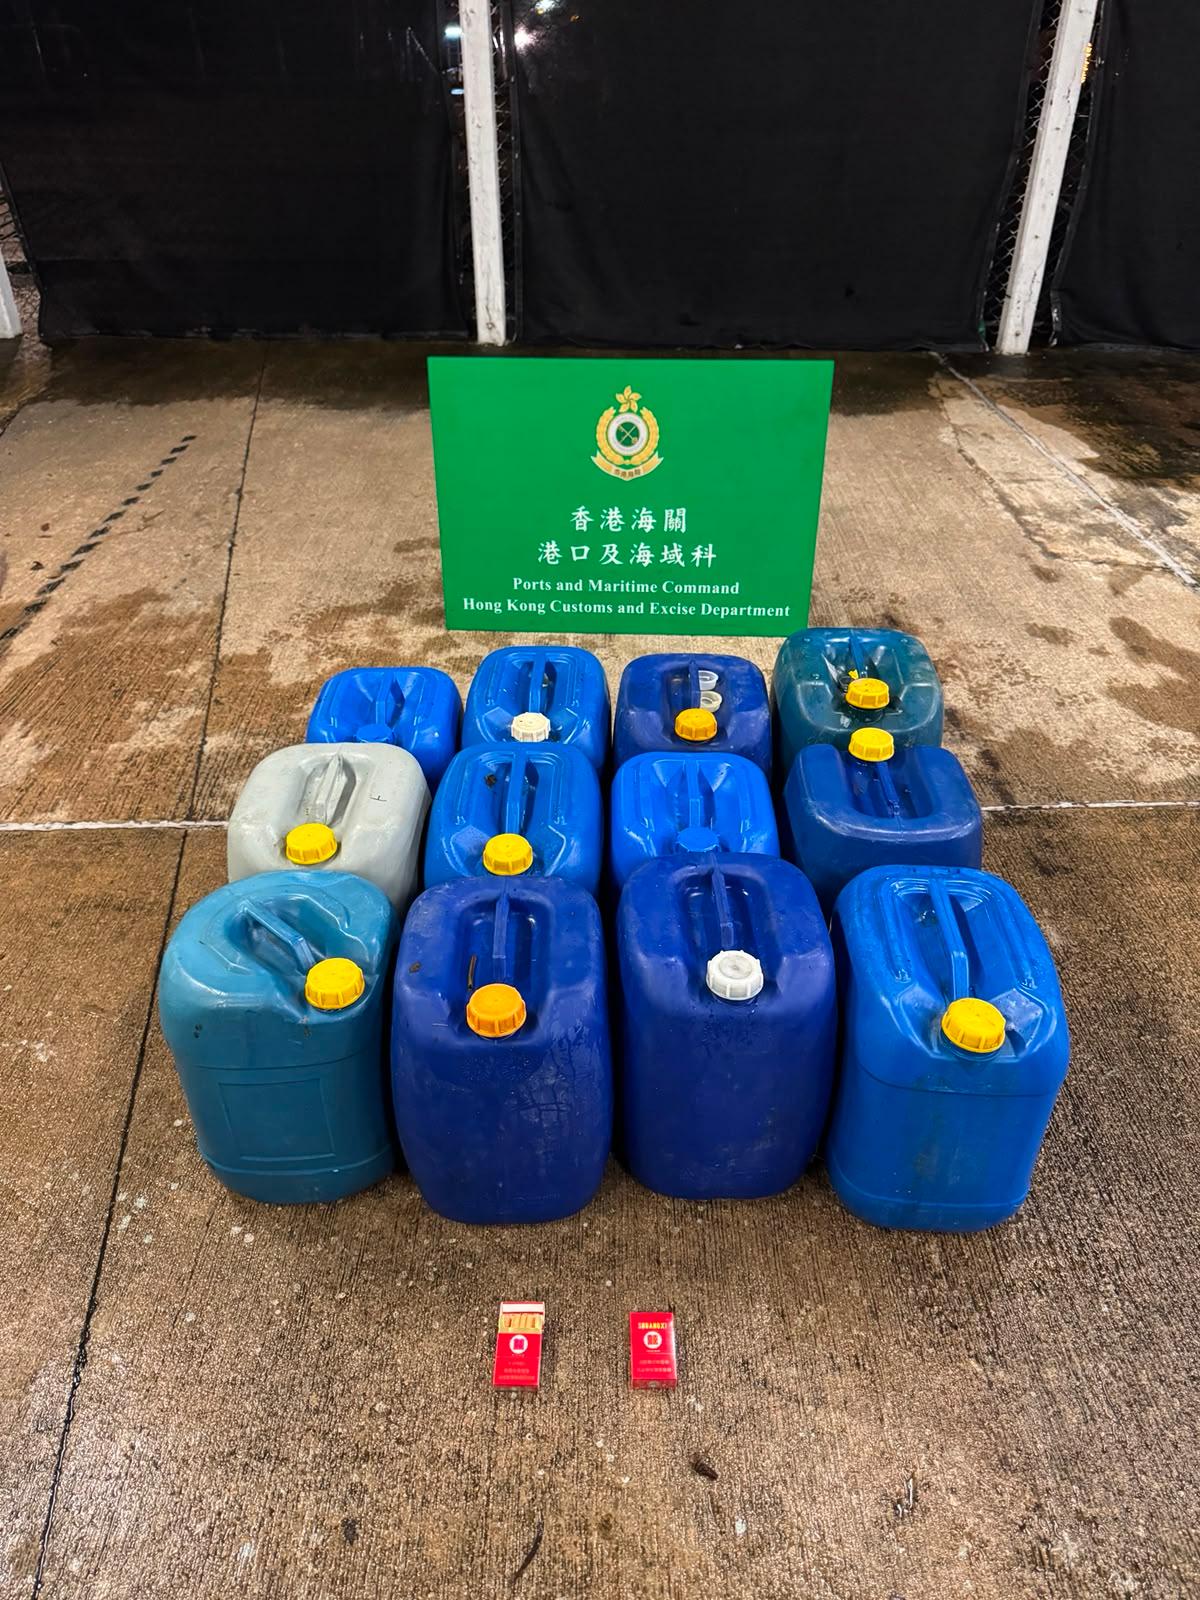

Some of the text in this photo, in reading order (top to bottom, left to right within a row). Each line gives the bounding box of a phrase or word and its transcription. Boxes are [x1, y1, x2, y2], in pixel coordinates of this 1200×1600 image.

[570, 505, 687, 533] 香港海關
[537, 540, 718, 568] 港口及海域科
[512, 577, 740, 596] Ports and Maritime Command
[463, 598, 791, 618] Hong Kong Customs and Excise Department
